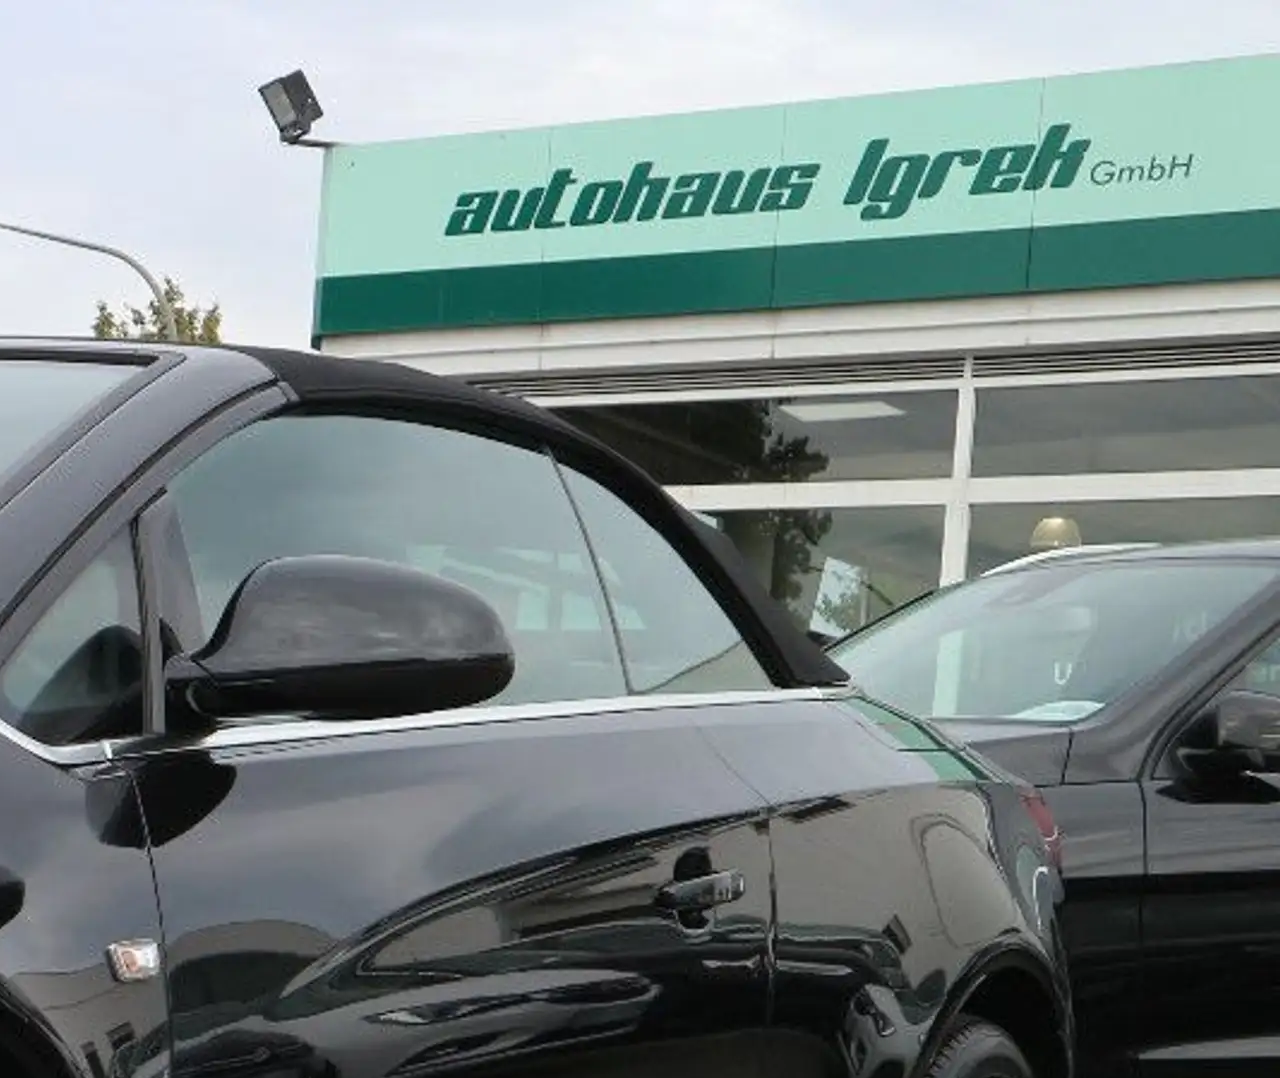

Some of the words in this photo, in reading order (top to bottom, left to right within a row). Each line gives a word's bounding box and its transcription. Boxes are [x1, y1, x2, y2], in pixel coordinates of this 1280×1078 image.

[444, 161, 821, 236] autohaus
[843, 123, 1091, 221] Igrek
[1091, 154, 1194, 186] GmbH
